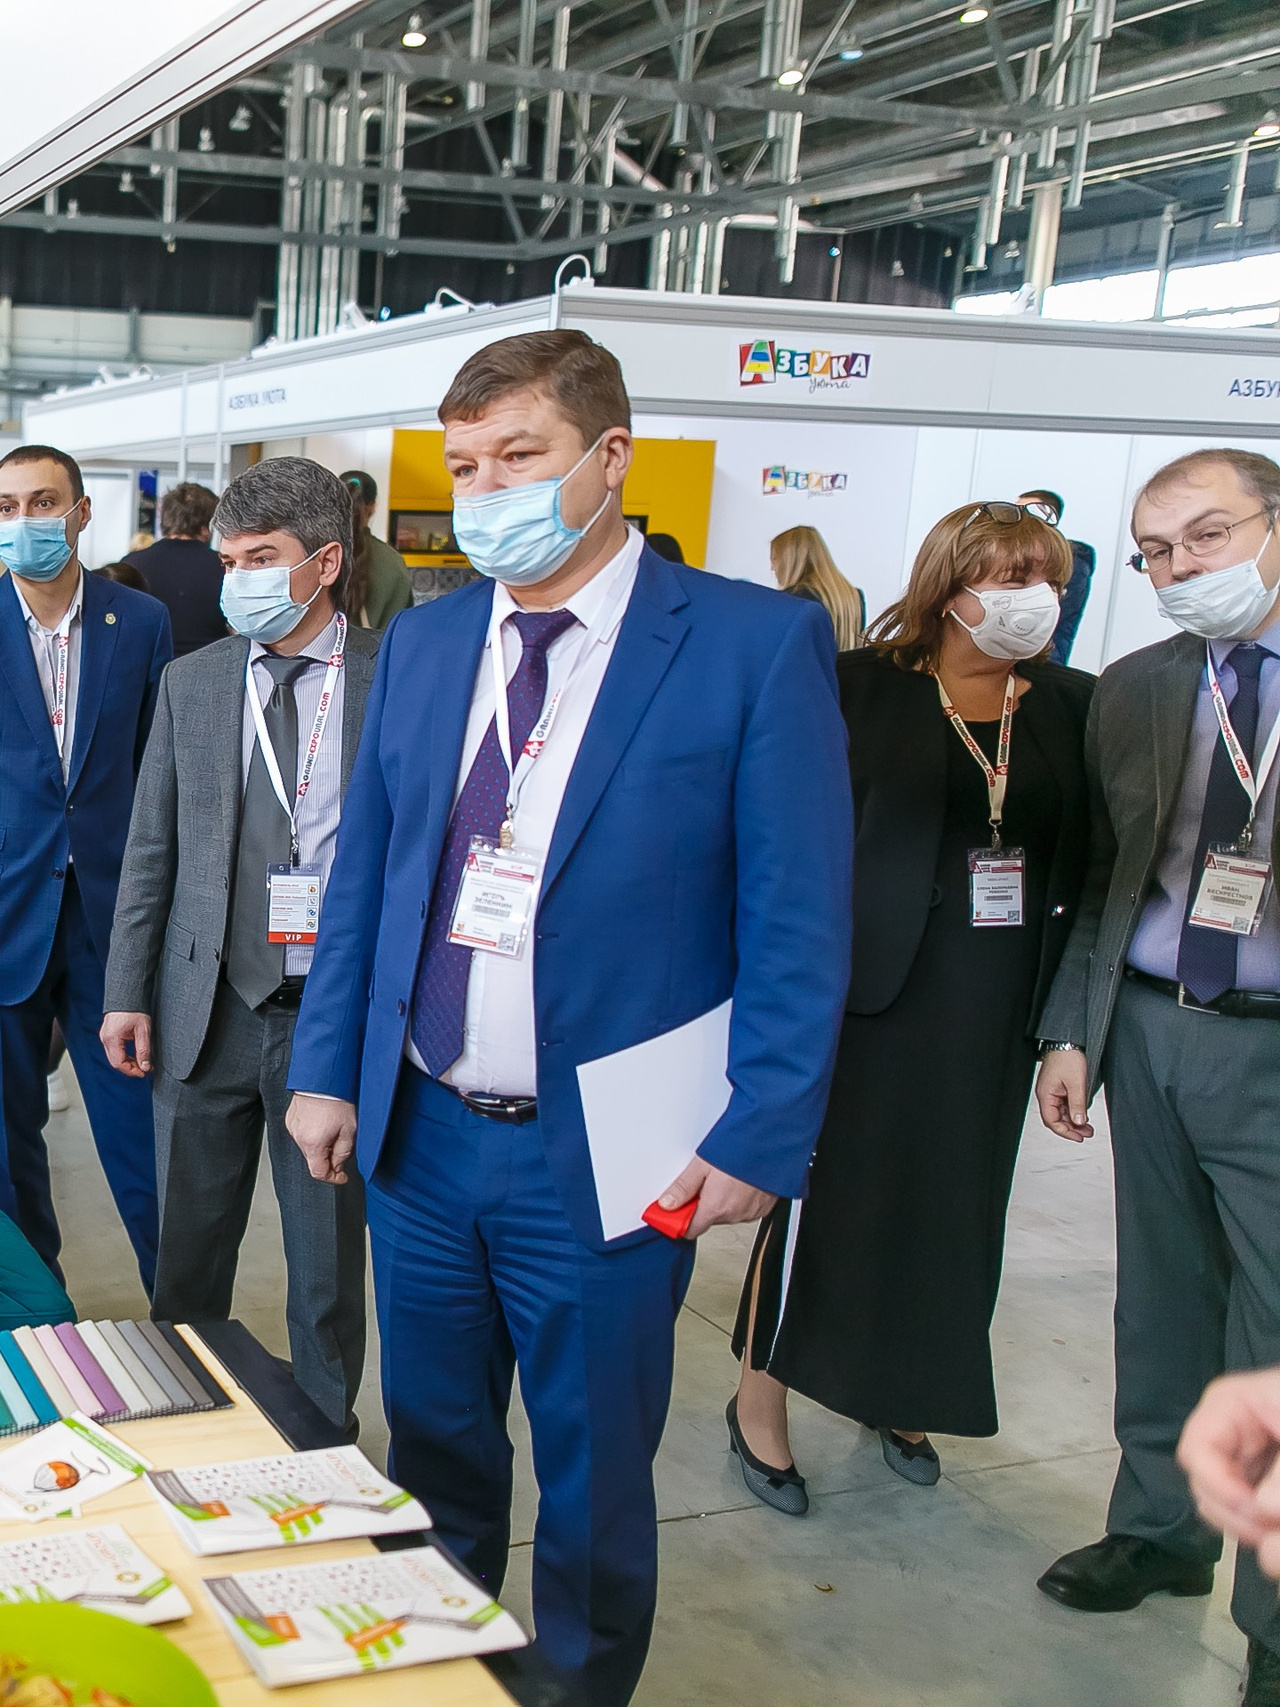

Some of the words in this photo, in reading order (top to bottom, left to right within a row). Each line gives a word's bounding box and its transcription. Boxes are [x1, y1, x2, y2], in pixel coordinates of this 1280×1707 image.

[740, 340, 870, 387] АЗБУКА
[1227, 379, 1280, 398] АЗБУ
[285, 933, 302, 941] VIP
